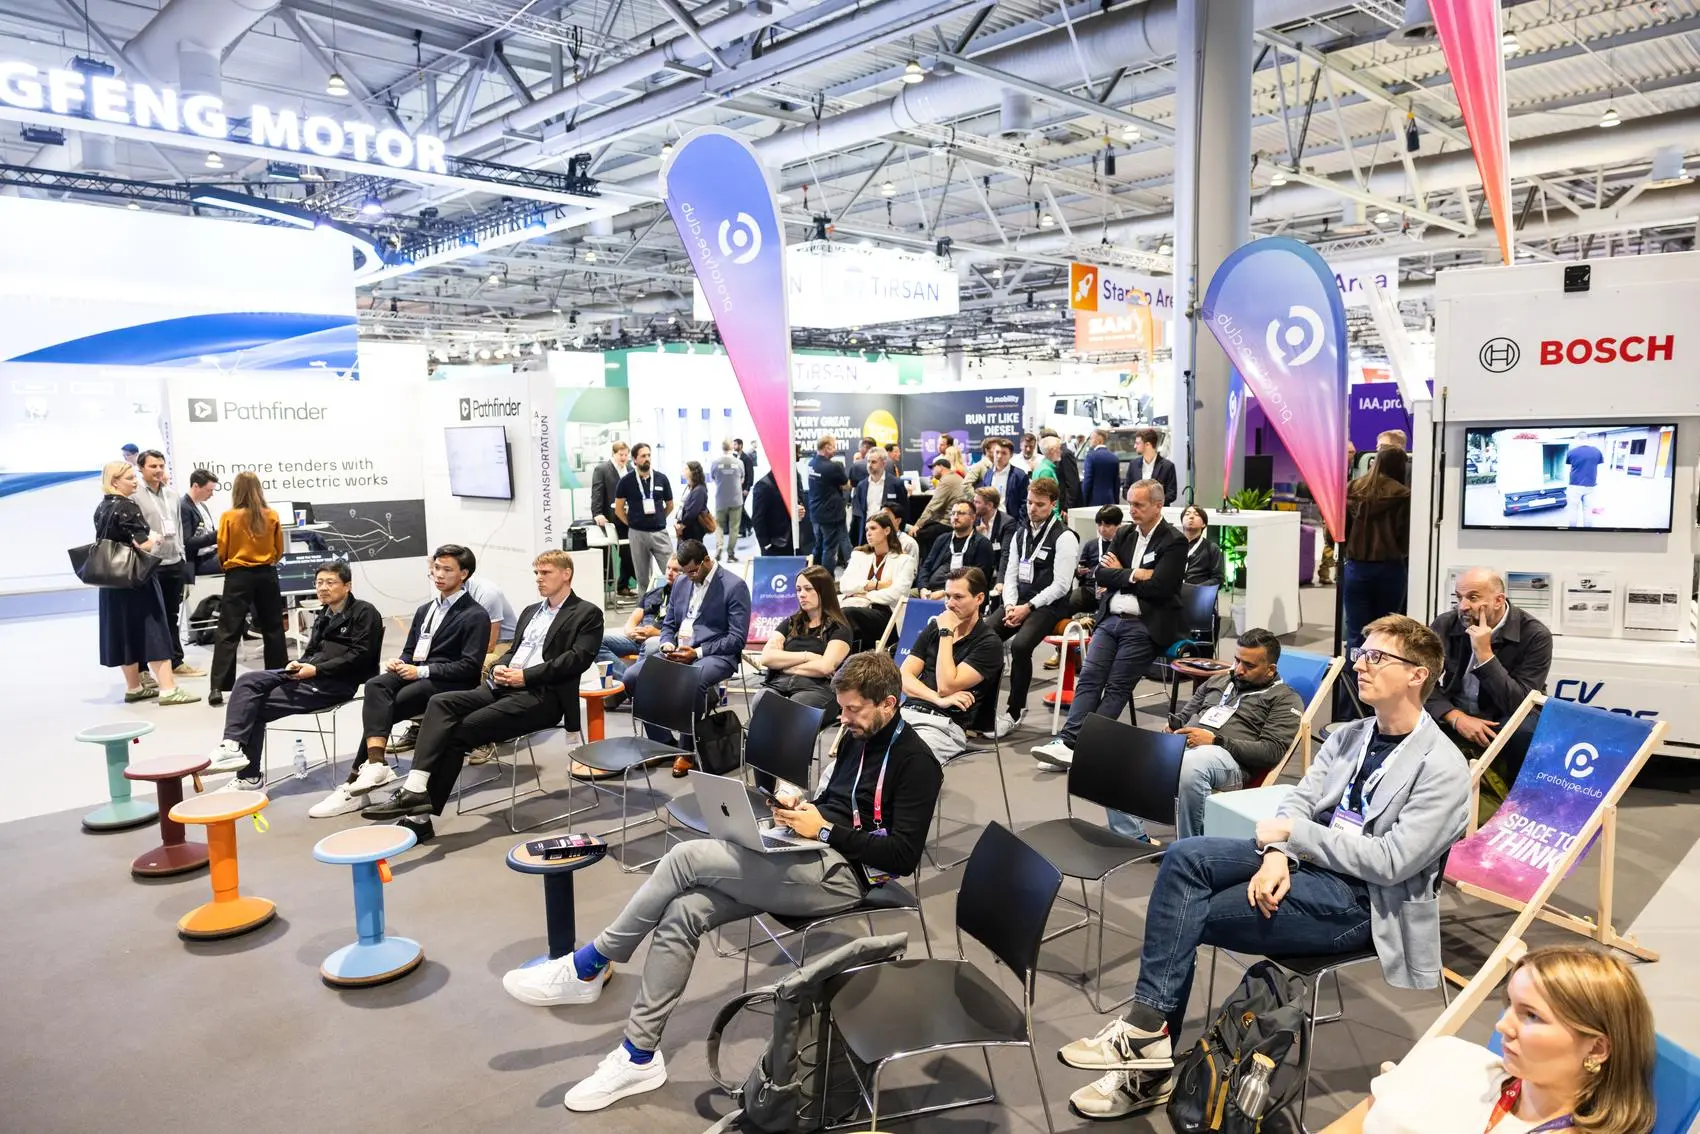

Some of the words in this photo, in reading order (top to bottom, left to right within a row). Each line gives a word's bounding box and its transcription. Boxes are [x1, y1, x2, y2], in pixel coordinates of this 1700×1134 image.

[250, 105, 447, 174] MOTOR
[1103, 280, 1152, 305] Starp
[1540, 335, 1674, 365] BOSCH
[223, 401, 327, 420] Pathfinder
[473, 398, 521, 418] Pathfinder
[965, 413, 986, 424] RUN
[987, 413, 997, 424] IT
[998, 413, 1019, 423] LIKE
[820, 416, 850, 427] GREAT
[193, 461, 226, 474] Win
[231, 463, 273, 473] more
[279, 459, 337, 472] tenders
[342, 457, 373, 471] with
[541, 415, 551, 513] TRANSPORTATION
[282, 475, 341, 489] electric
[345, 474, 388, 487] works
[544, 516, 552, 535] IAA
[1536, 771, 1603, 799] prototype.club
[1504, 813, 1557, 844] SPACE
[1486, 827, 1566, 873] THINK
